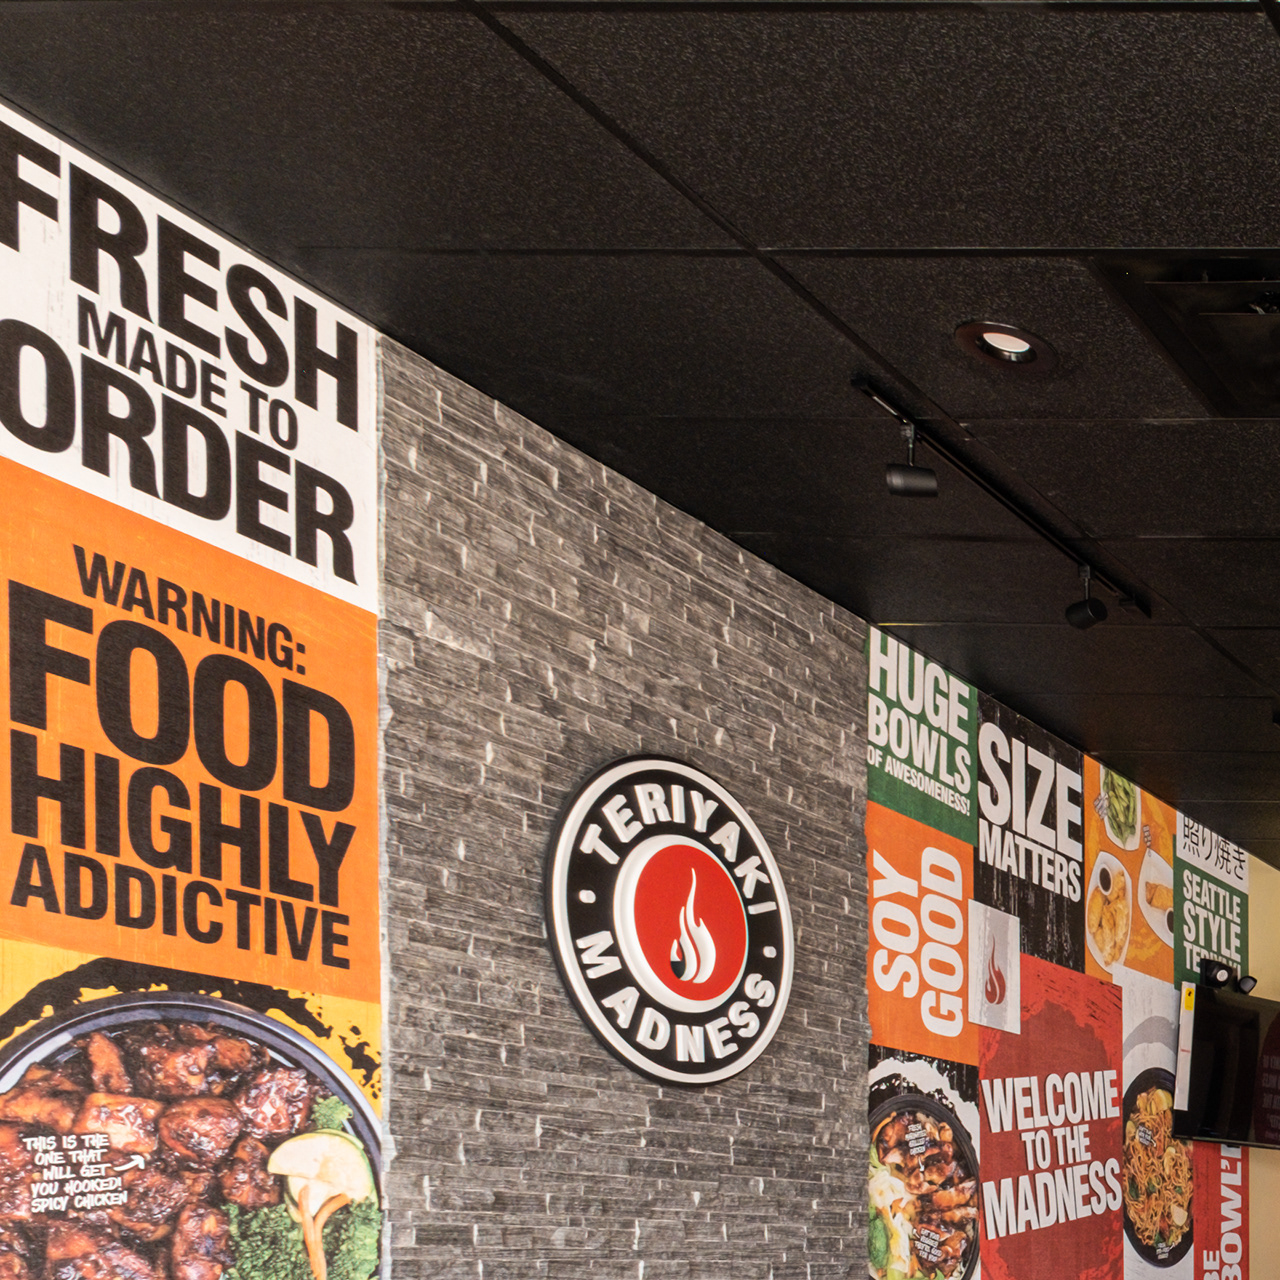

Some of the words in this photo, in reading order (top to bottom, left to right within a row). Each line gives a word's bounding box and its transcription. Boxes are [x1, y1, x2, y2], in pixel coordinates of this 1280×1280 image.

[0, 120, 359, 432] FRESH
[77, 293, 227, 419] MADE
[240, 379, 299, 451] TO
[0, 318, 359, 586] ORDER
[72, 543, 306, 675] WARNING:
[8, 578, 355, 813] FOOD
[869, 625, 969, 745] HUGE
[866, 744, 884, 767] OF
[884, 755, 971, 816] AWESOMENESS!
[867, 692, 972, 795] BOWLS
[977, 721, 1083, 862] SIZE
[10, 728, 357, 908] HIGHLY
[579, 783, 777, 915] TERIYAKI
[978, 817, 1081, 903] MATTERS
[1183, 815, 1246, 881] 照り焼き
[10, 842, 351, 970] ADDICTIVE
[872, 848, 919, 999] SOY
[920, 846, 964, 1038] GOOD
[1182, 868, 1241, 924] SEATTLE
[1182, 900, 1241, 963] STYLE
[576, 930, 776, 1062] MADNESS
[22, 1136, 57, 1149] THIS
[62, 1135, 76, 1149] IS
[80, 1134, 109, 1148] THE
[981, 1069, 1120, 1134] WELCOME
[1021, 1131, 1051, 1171] TO
[1053, 1124, 1092, 1165] THE
[31, 1182, 60, 1197] YOU
[64, 1177, 122, 1193] HOOKED!
[31, 1197, 69, 1212] SPICY
[75, 1191, 128, 1209] CHICKEN
[35, 1152, 64, 1166] ONE
[69, 1150, 106, 1163] THAT
[43, 1167, 76, 1180] WILL
[80, 1164, 109, 1178] GET
[981, 1157, 1123, 1241] MADNESS
